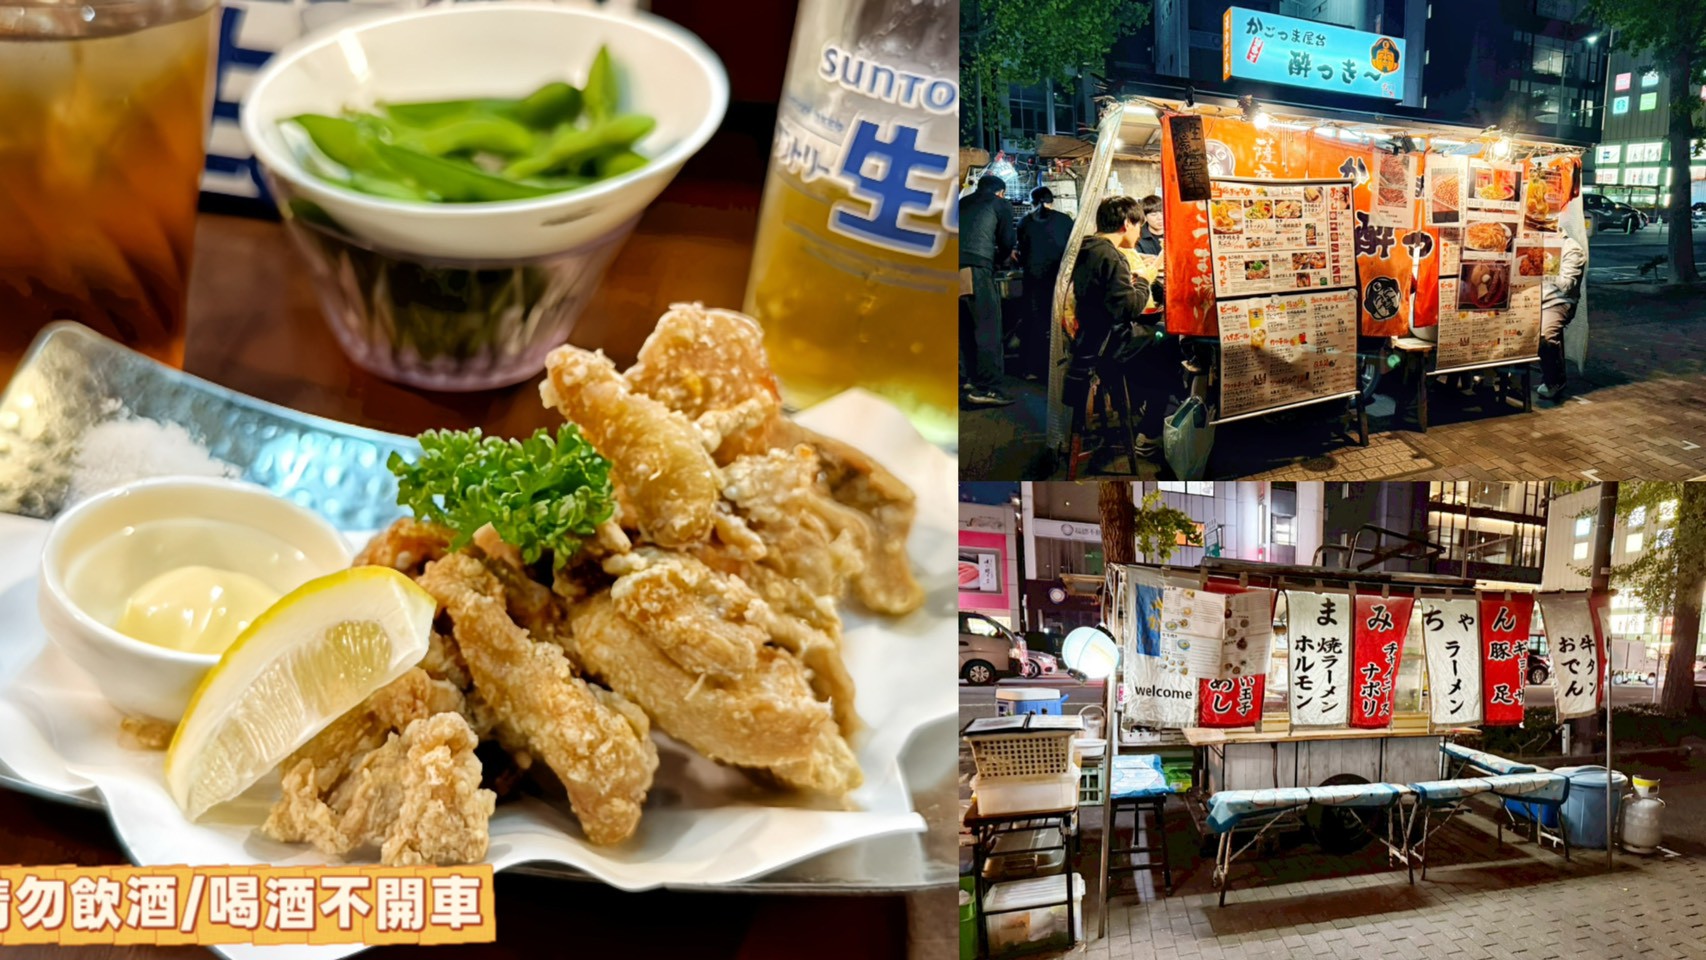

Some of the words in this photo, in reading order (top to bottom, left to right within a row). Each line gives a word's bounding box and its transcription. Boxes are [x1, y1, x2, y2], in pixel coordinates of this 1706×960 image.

[1134, 684, 1193, 700] welcome
[1294, 634, 1315, 711] ホルモン
[1316, 636, 1343, 714] 焼ラーメン
[1360, 662, 1381, 718] ナポリ
[1445, 639, 1465, 715] ラーメン
[1488, 640, 1514, 705] 豚足
[1558, 636, 1584, 698] おでん
[1579, 634, 1598, 697] 牛タン
